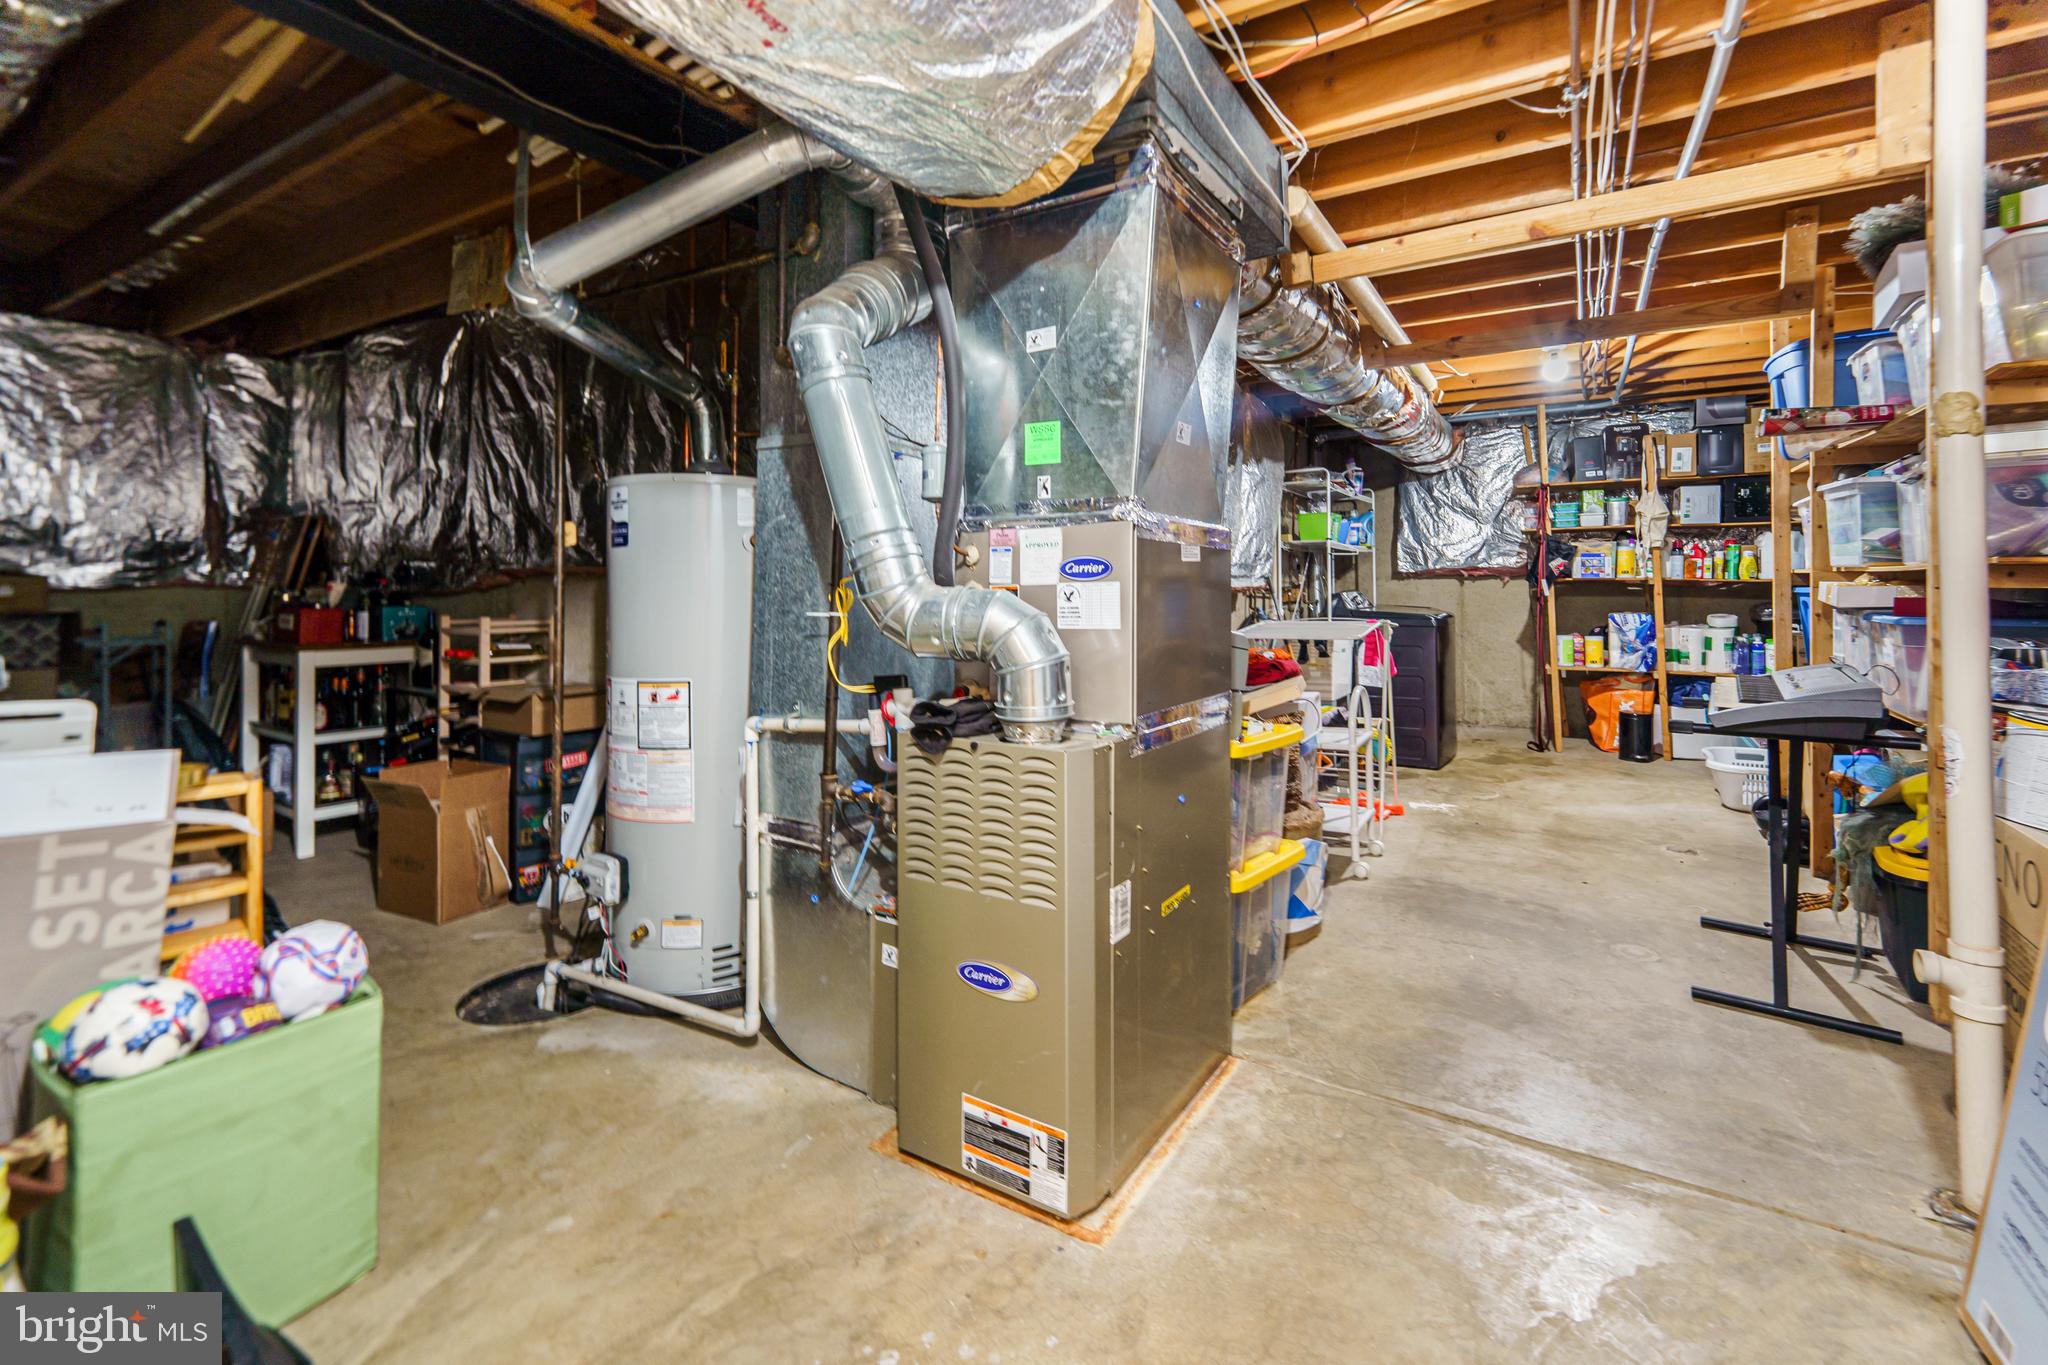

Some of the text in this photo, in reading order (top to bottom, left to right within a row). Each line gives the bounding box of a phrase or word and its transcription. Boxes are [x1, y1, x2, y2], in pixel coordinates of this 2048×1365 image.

[1065, 562, 1105, 574] Carrier
[29, 832, 109, 949] SET
[963, 966, 1006, 987] Carrier
